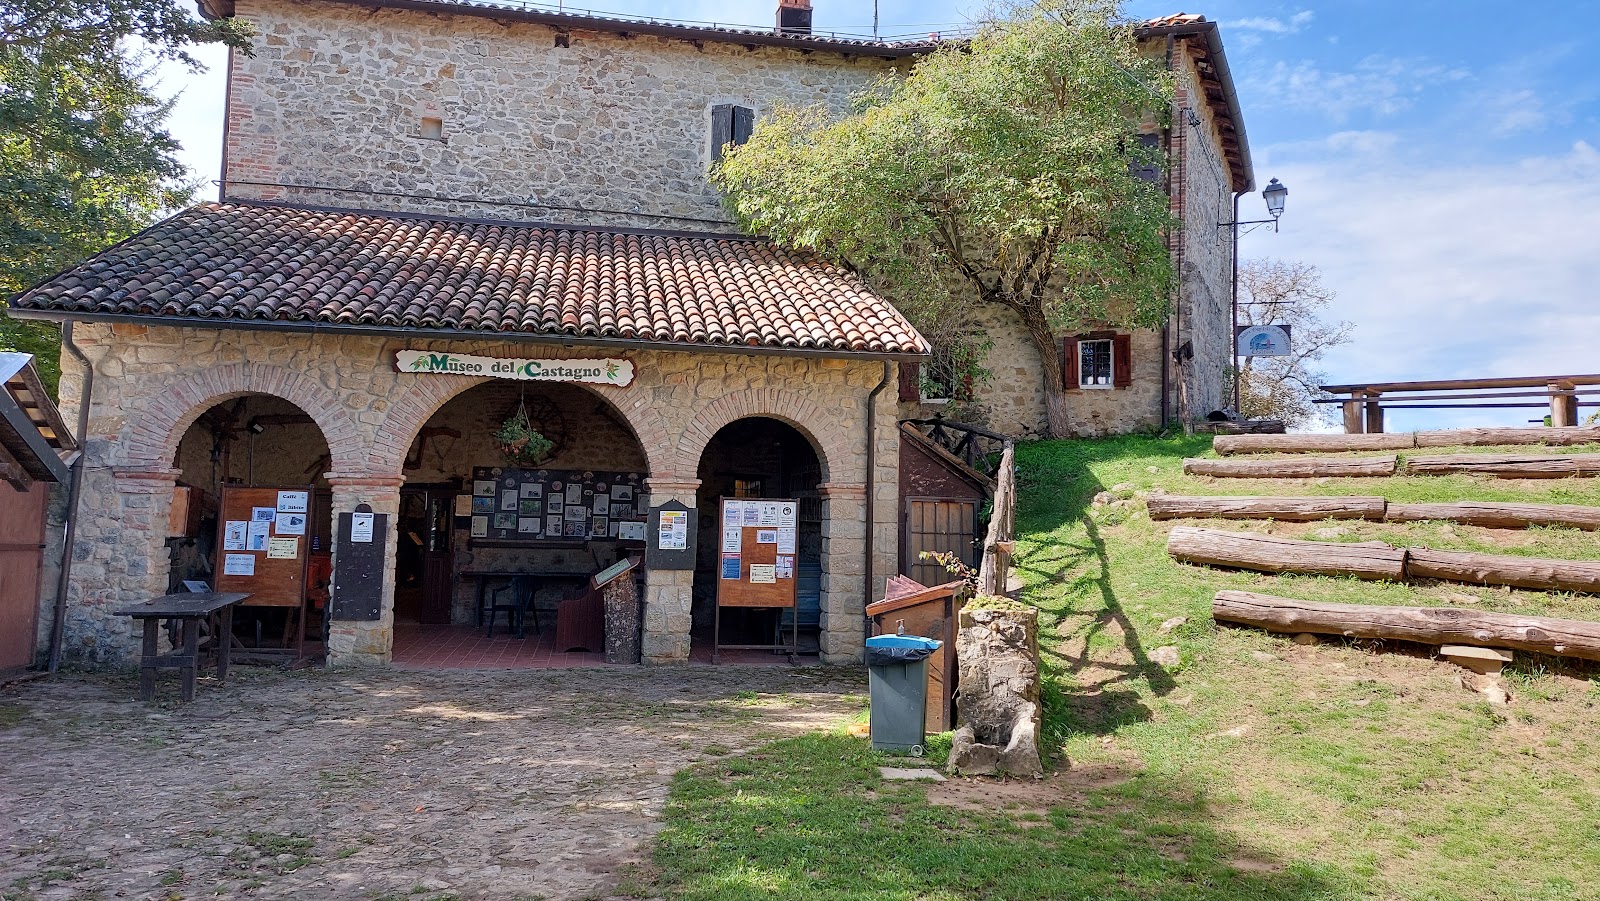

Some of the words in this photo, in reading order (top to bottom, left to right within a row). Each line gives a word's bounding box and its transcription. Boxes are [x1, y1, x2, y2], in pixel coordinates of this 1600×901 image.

[428, 354, 482, 372] Museo
[491, 361, 515, 373] del
[524, 361, 601, 379] Castagno
